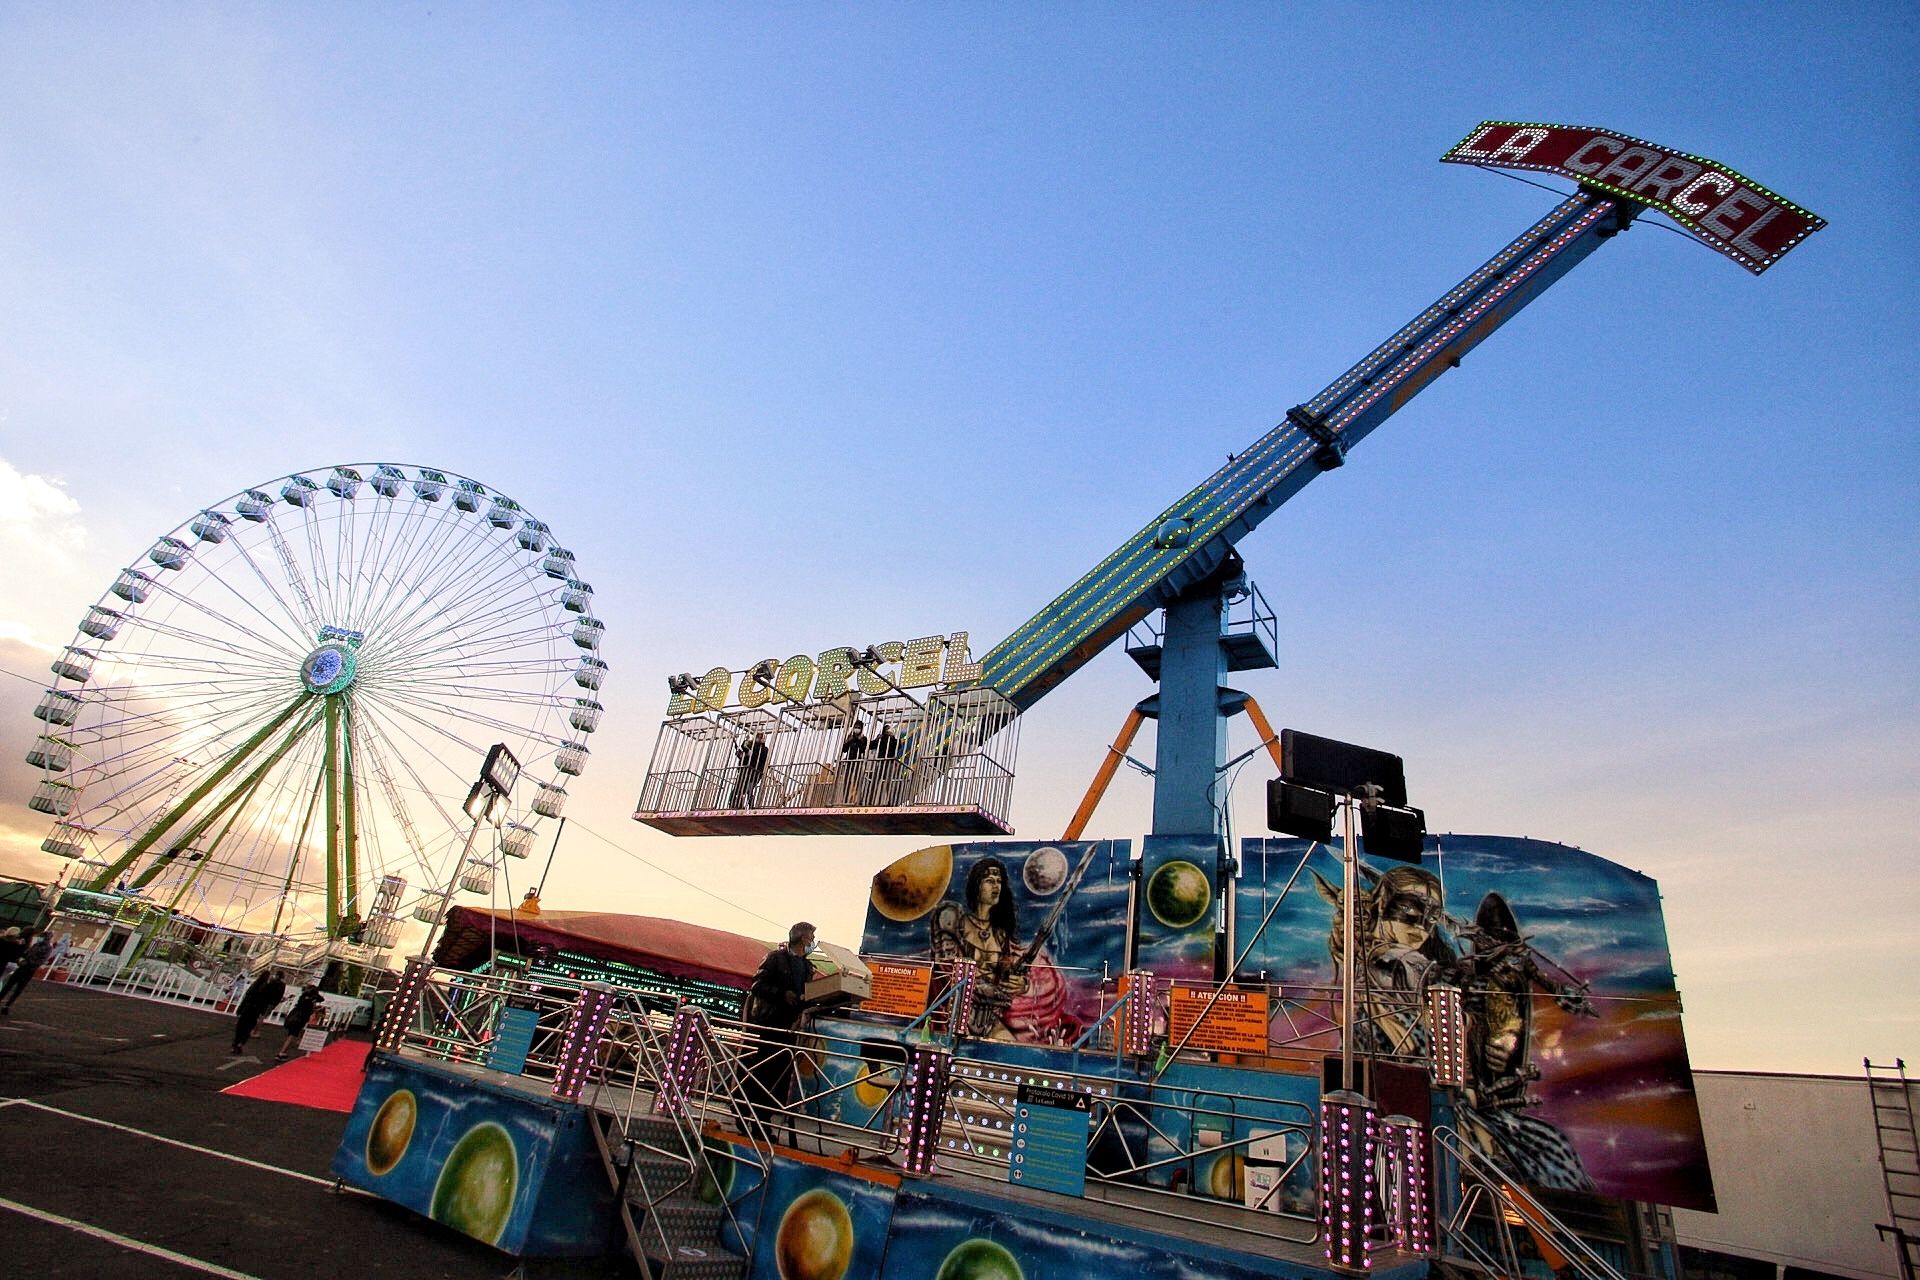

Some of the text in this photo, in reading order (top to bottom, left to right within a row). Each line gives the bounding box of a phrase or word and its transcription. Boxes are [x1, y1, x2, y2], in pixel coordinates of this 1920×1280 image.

[1454, 126, 1782, 260] LA CARCEL
[738, 631, 984, 708] CARCEL
[1051, 1090, 1067, 1100] Covid
